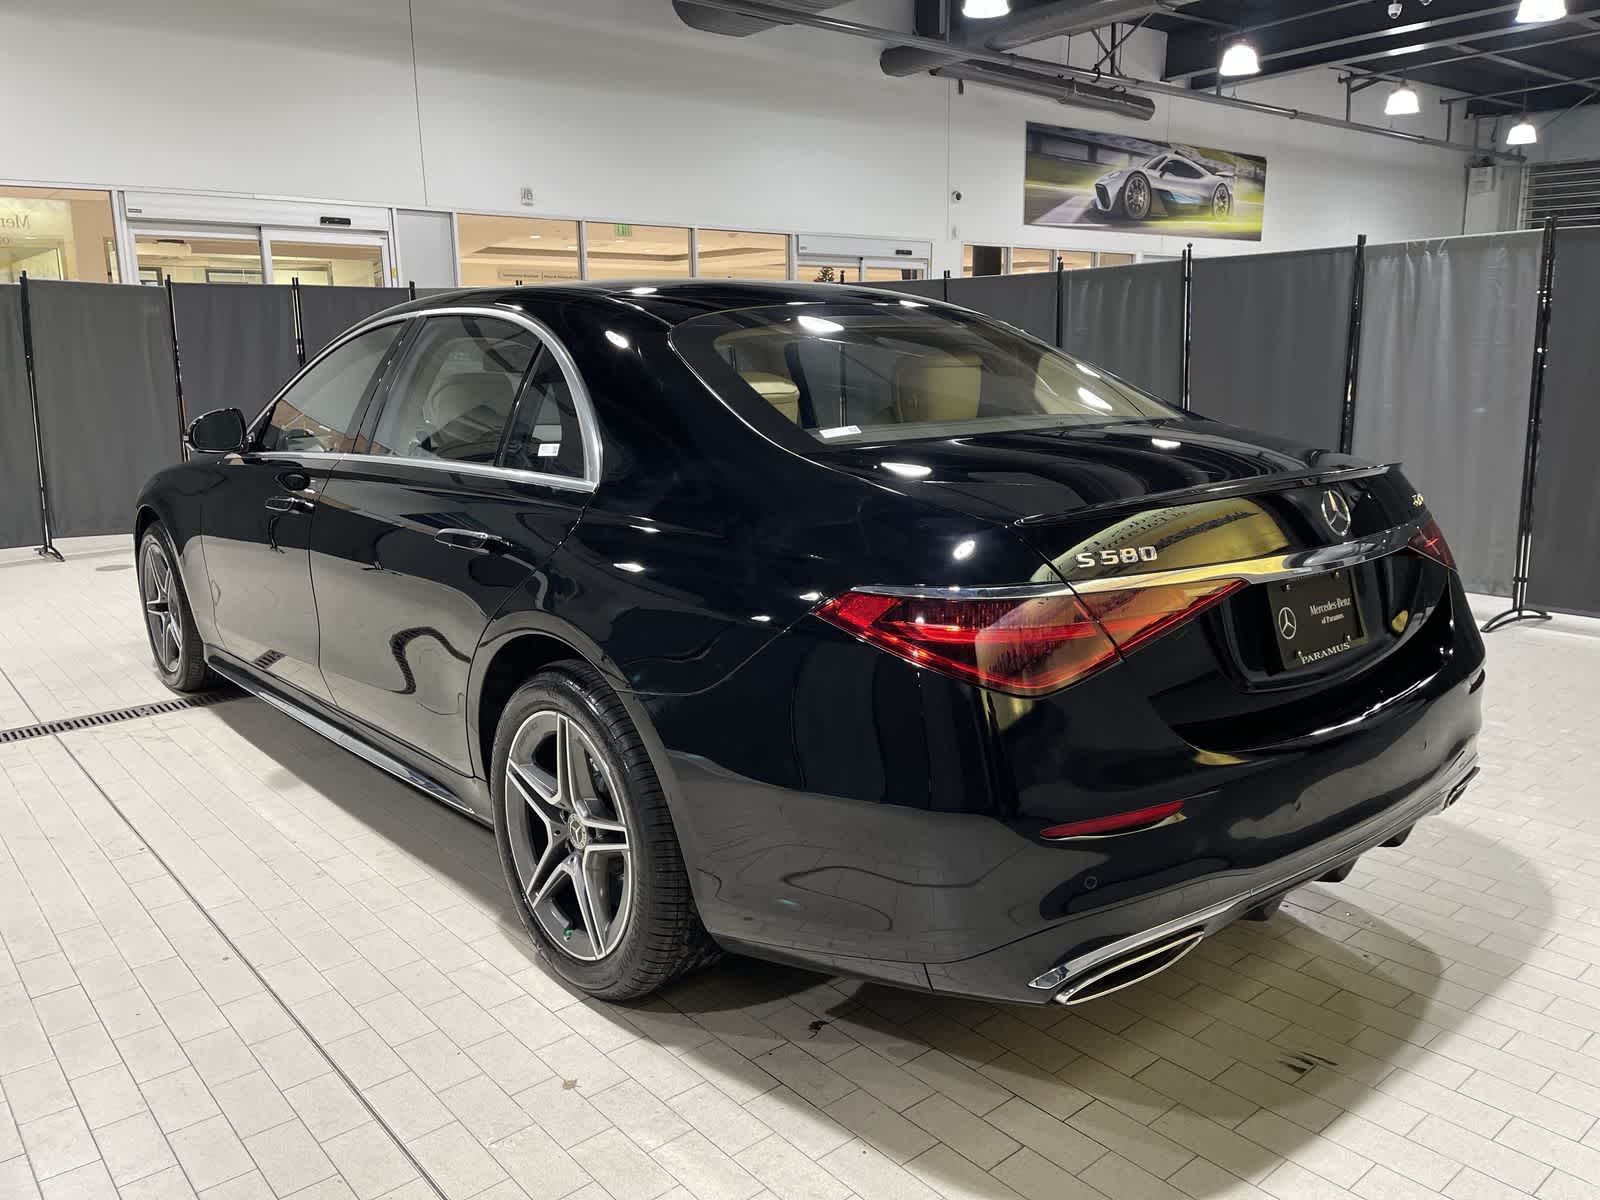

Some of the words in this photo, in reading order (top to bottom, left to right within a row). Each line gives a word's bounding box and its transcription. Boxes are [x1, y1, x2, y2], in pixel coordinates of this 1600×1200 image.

[1077, 552, 1095, 568] S
[1100, 546, 1157, 565] 580
[1310, 597, 1351, 615] Mercedes-Benz
[1302, 642, 1350, 664] PARAMUS
